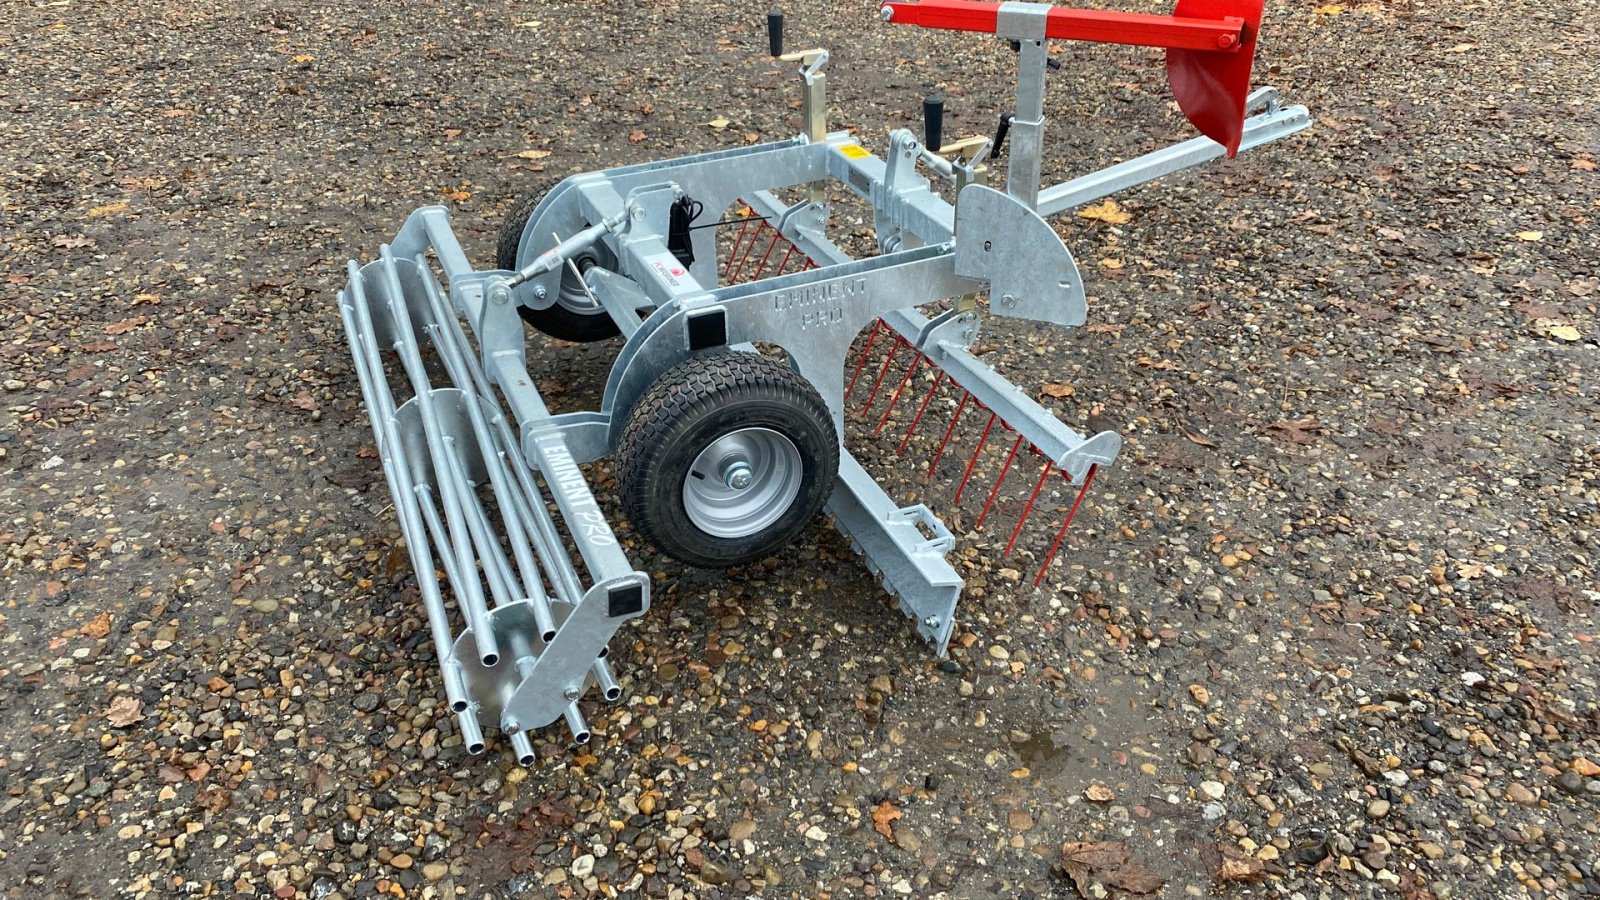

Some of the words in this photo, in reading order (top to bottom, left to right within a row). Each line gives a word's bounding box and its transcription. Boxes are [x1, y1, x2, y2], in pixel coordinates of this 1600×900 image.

[774, 278, 866, 312] EMINENT
[801, 307, 843, 331] PRO
[543, 445, 597, 507] EMINENT
[574, 509, 617, 546] PRO
